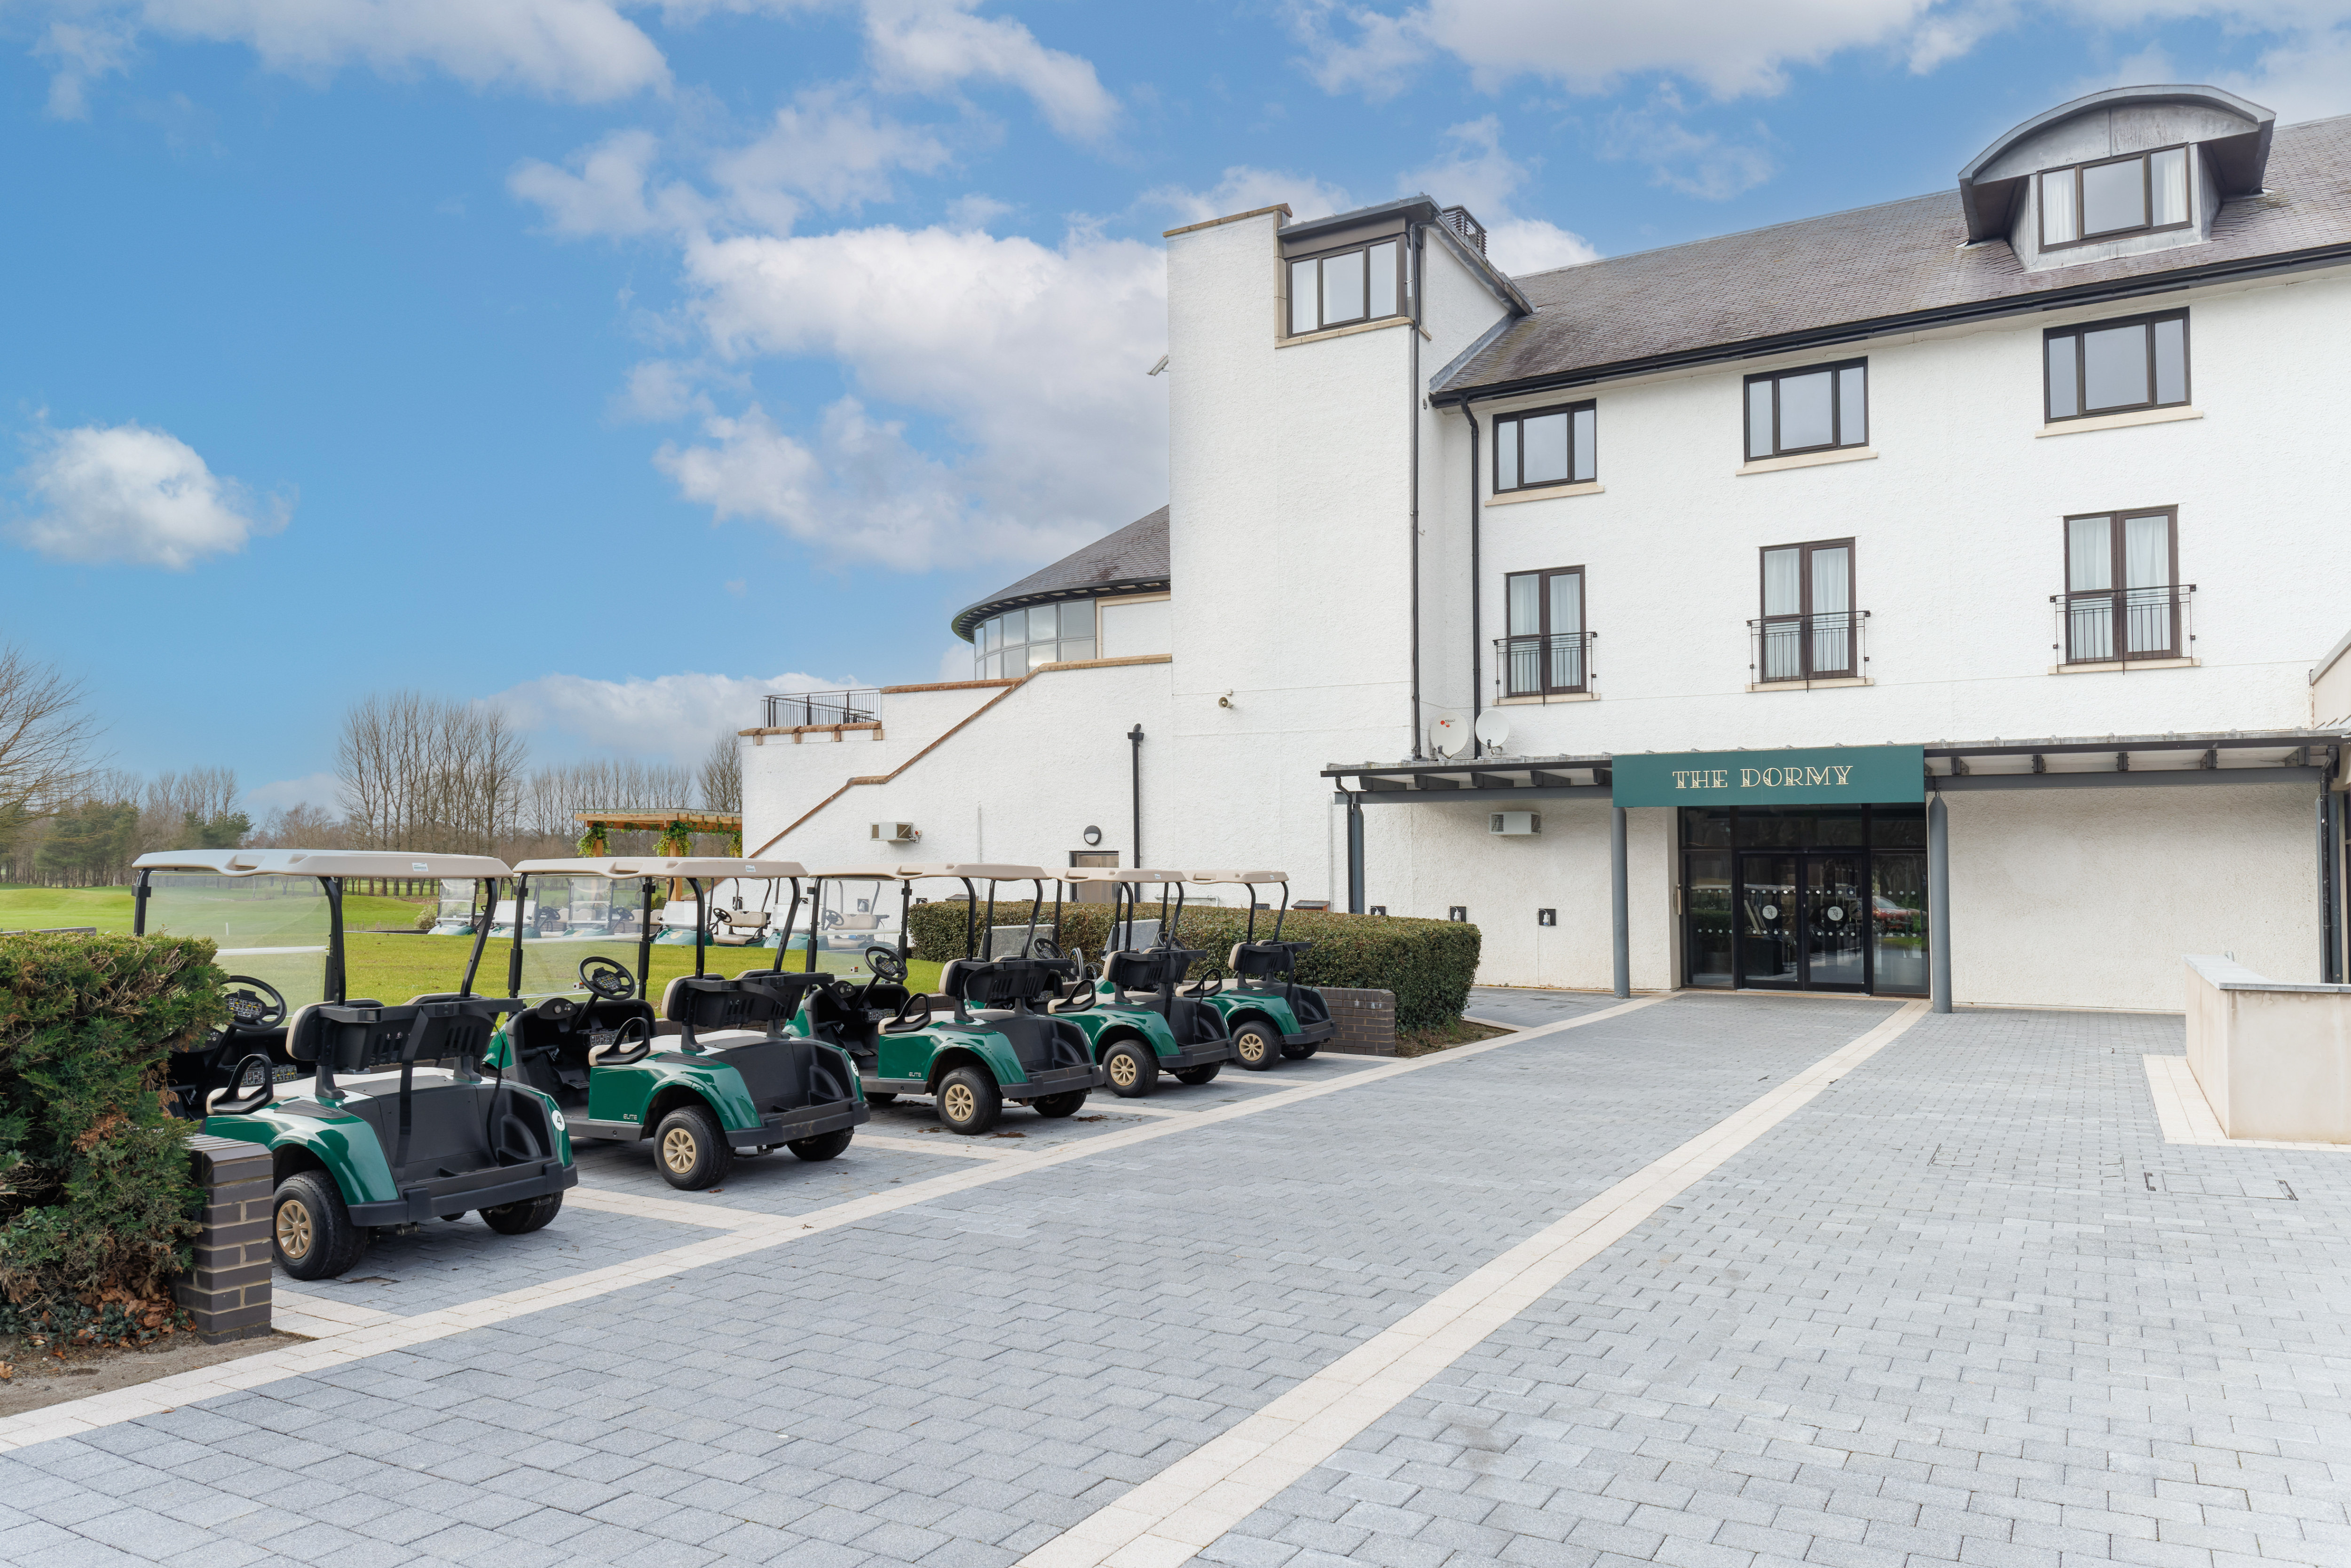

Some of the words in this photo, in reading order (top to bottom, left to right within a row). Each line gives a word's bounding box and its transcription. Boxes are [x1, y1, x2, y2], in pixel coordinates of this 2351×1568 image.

[1673, 770, 1728, 788] THE
[1740, 765, 1854, 787] DORMY
[557, 1115, 562, 1125] 4
